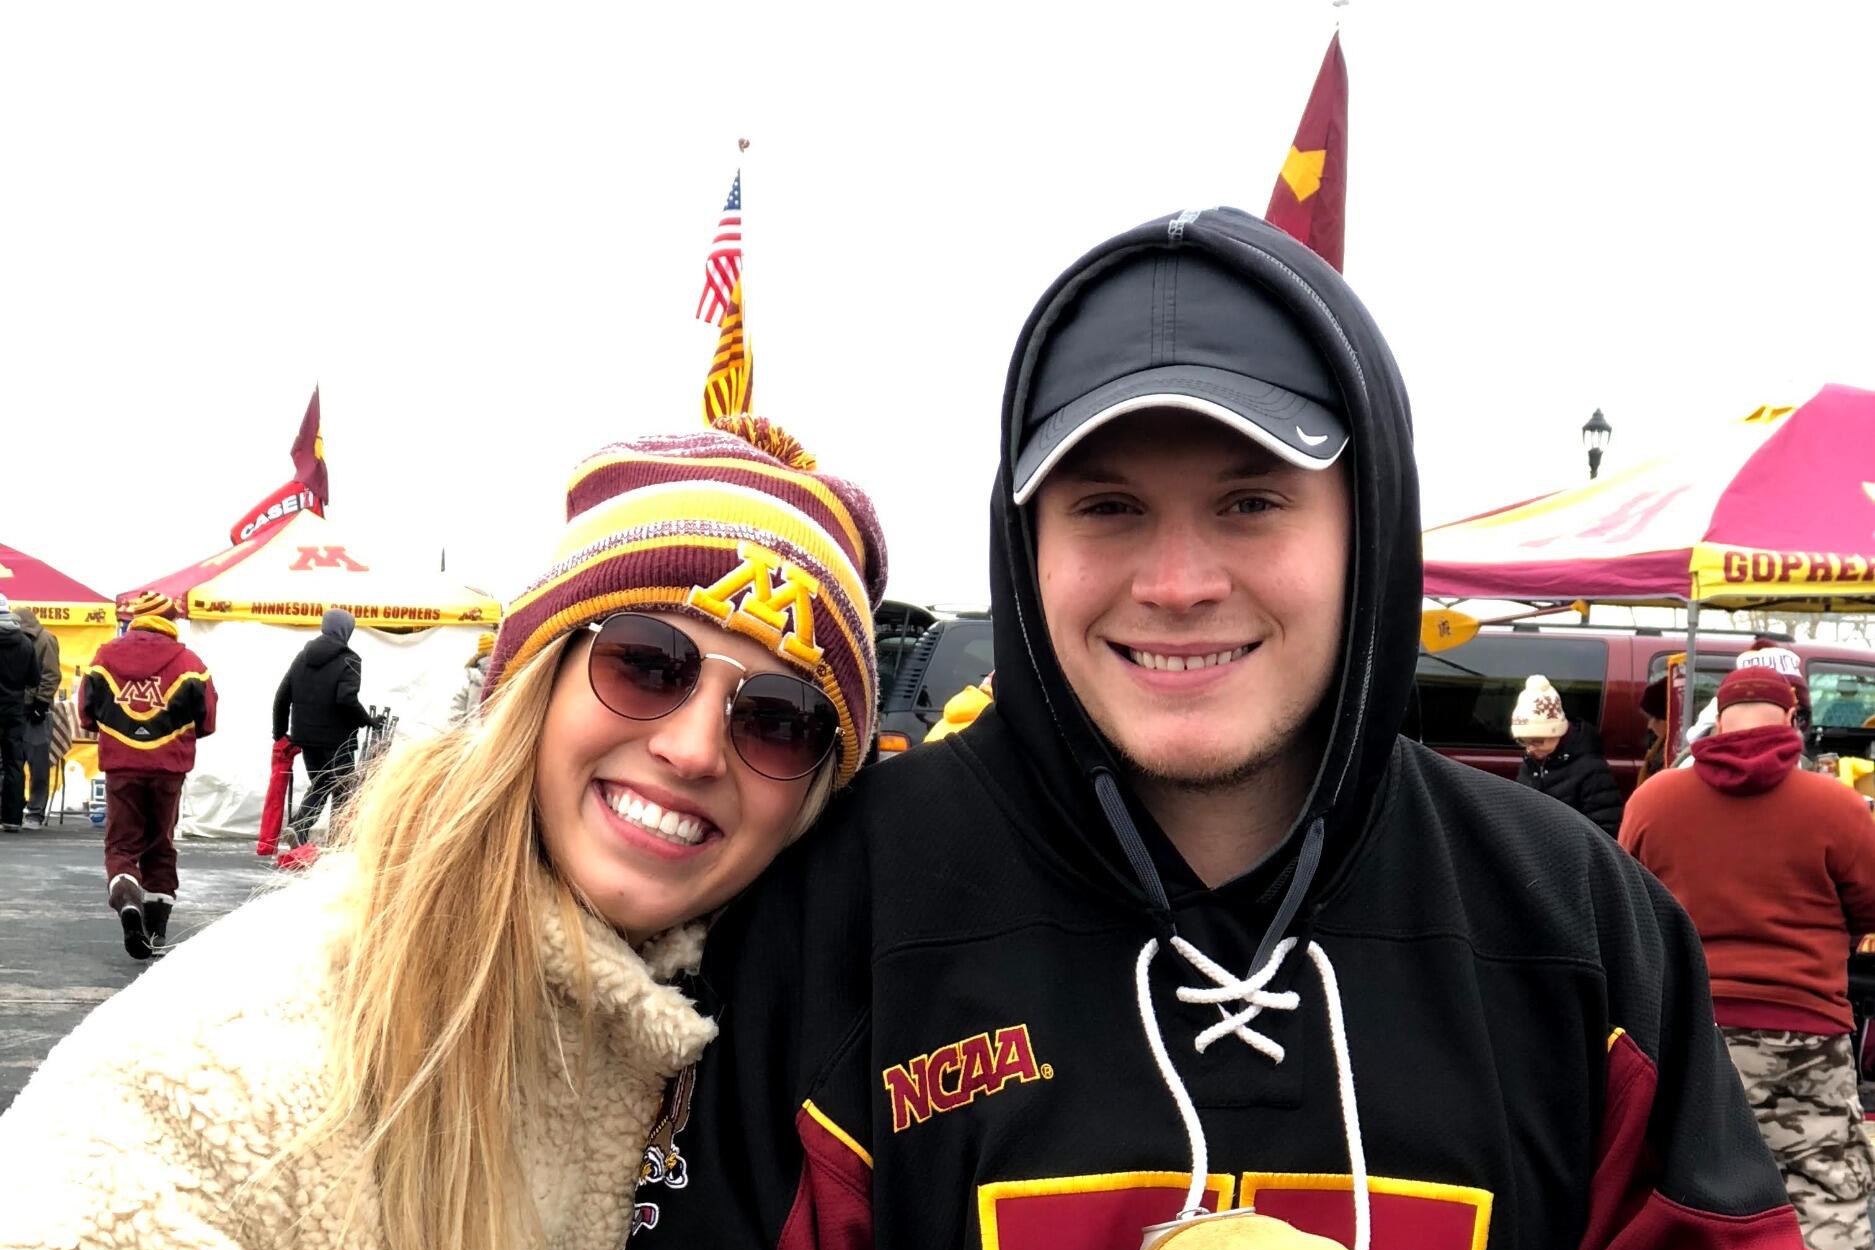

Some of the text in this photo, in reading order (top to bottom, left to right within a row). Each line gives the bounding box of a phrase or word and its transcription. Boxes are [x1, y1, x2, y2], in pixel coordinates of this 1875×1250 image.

[240, 494, 299, 540] CASE
[251, 602, 441, 620] MINNESOTA DEN GOPHERS
